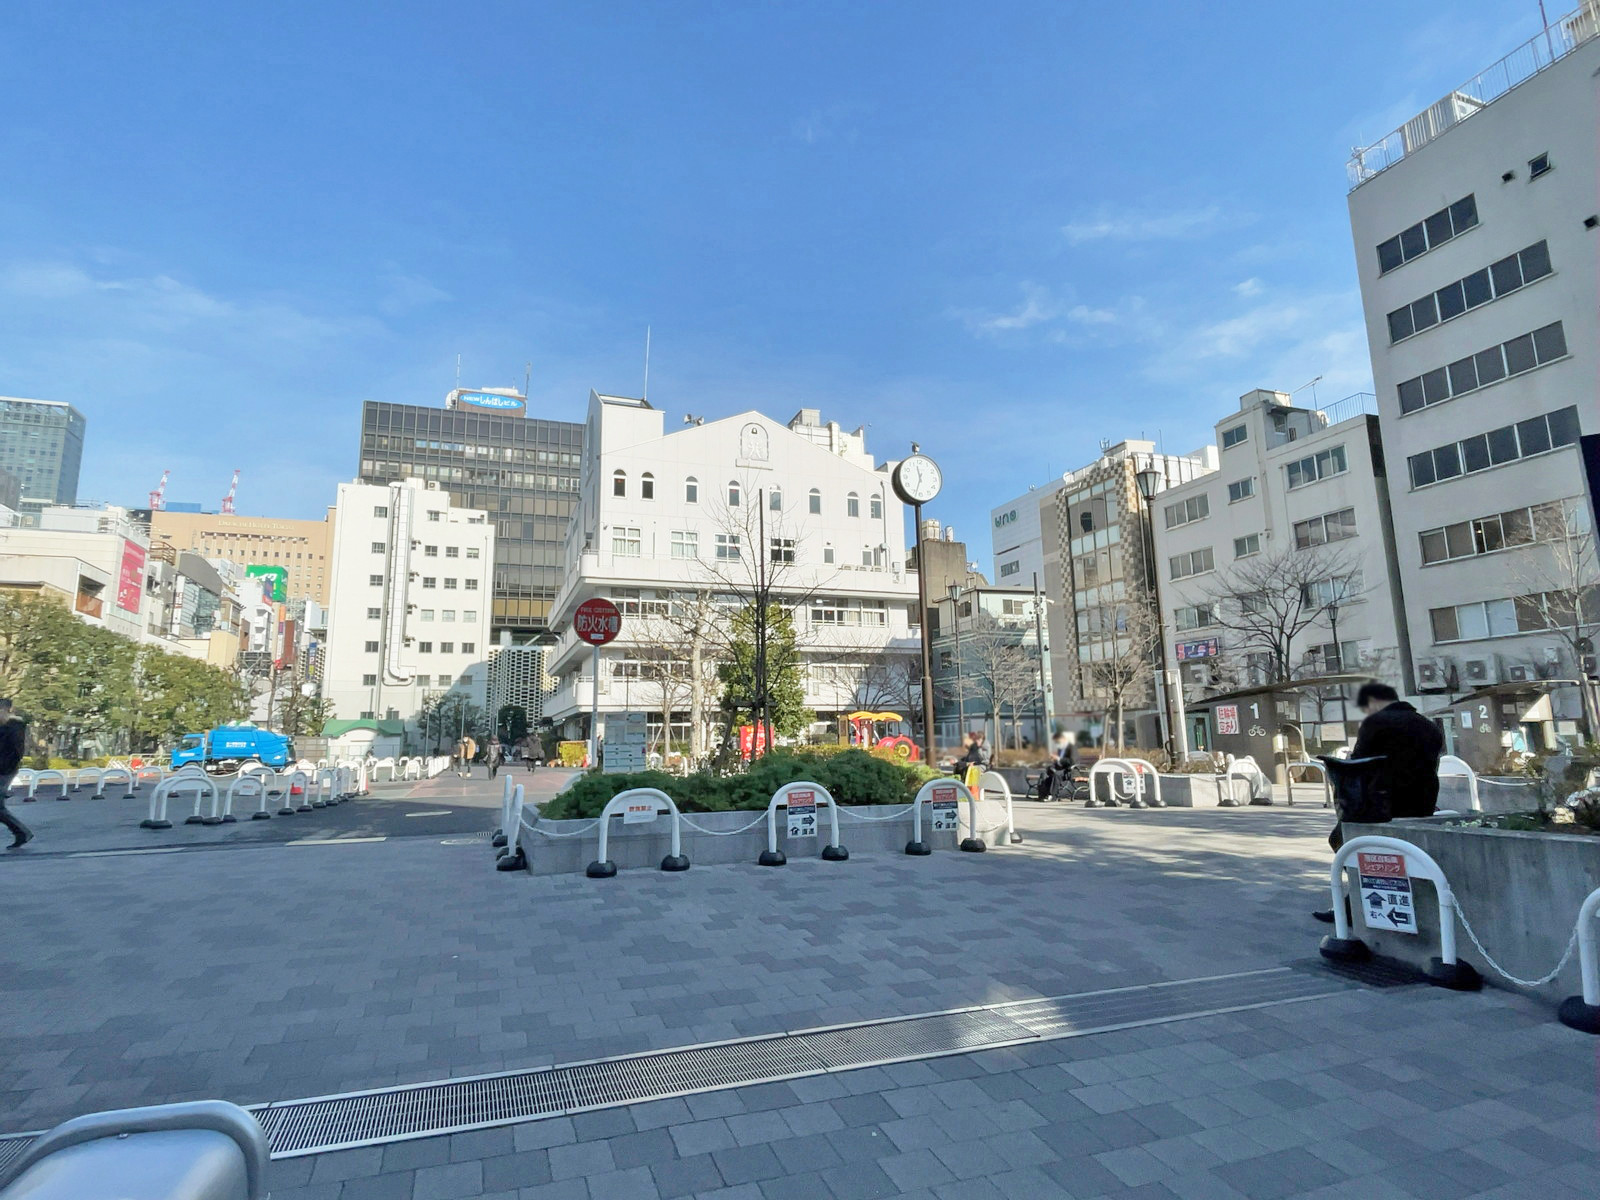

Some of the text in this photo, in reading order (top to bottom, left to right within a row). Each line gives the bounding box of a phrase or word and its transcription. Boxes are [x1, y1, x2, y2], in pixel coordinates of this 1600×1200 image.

[1250, 702, 1259, 719] 1
[1479, 704, 1488, 719] 2
[1388, 894, 1410, 906] 直進
